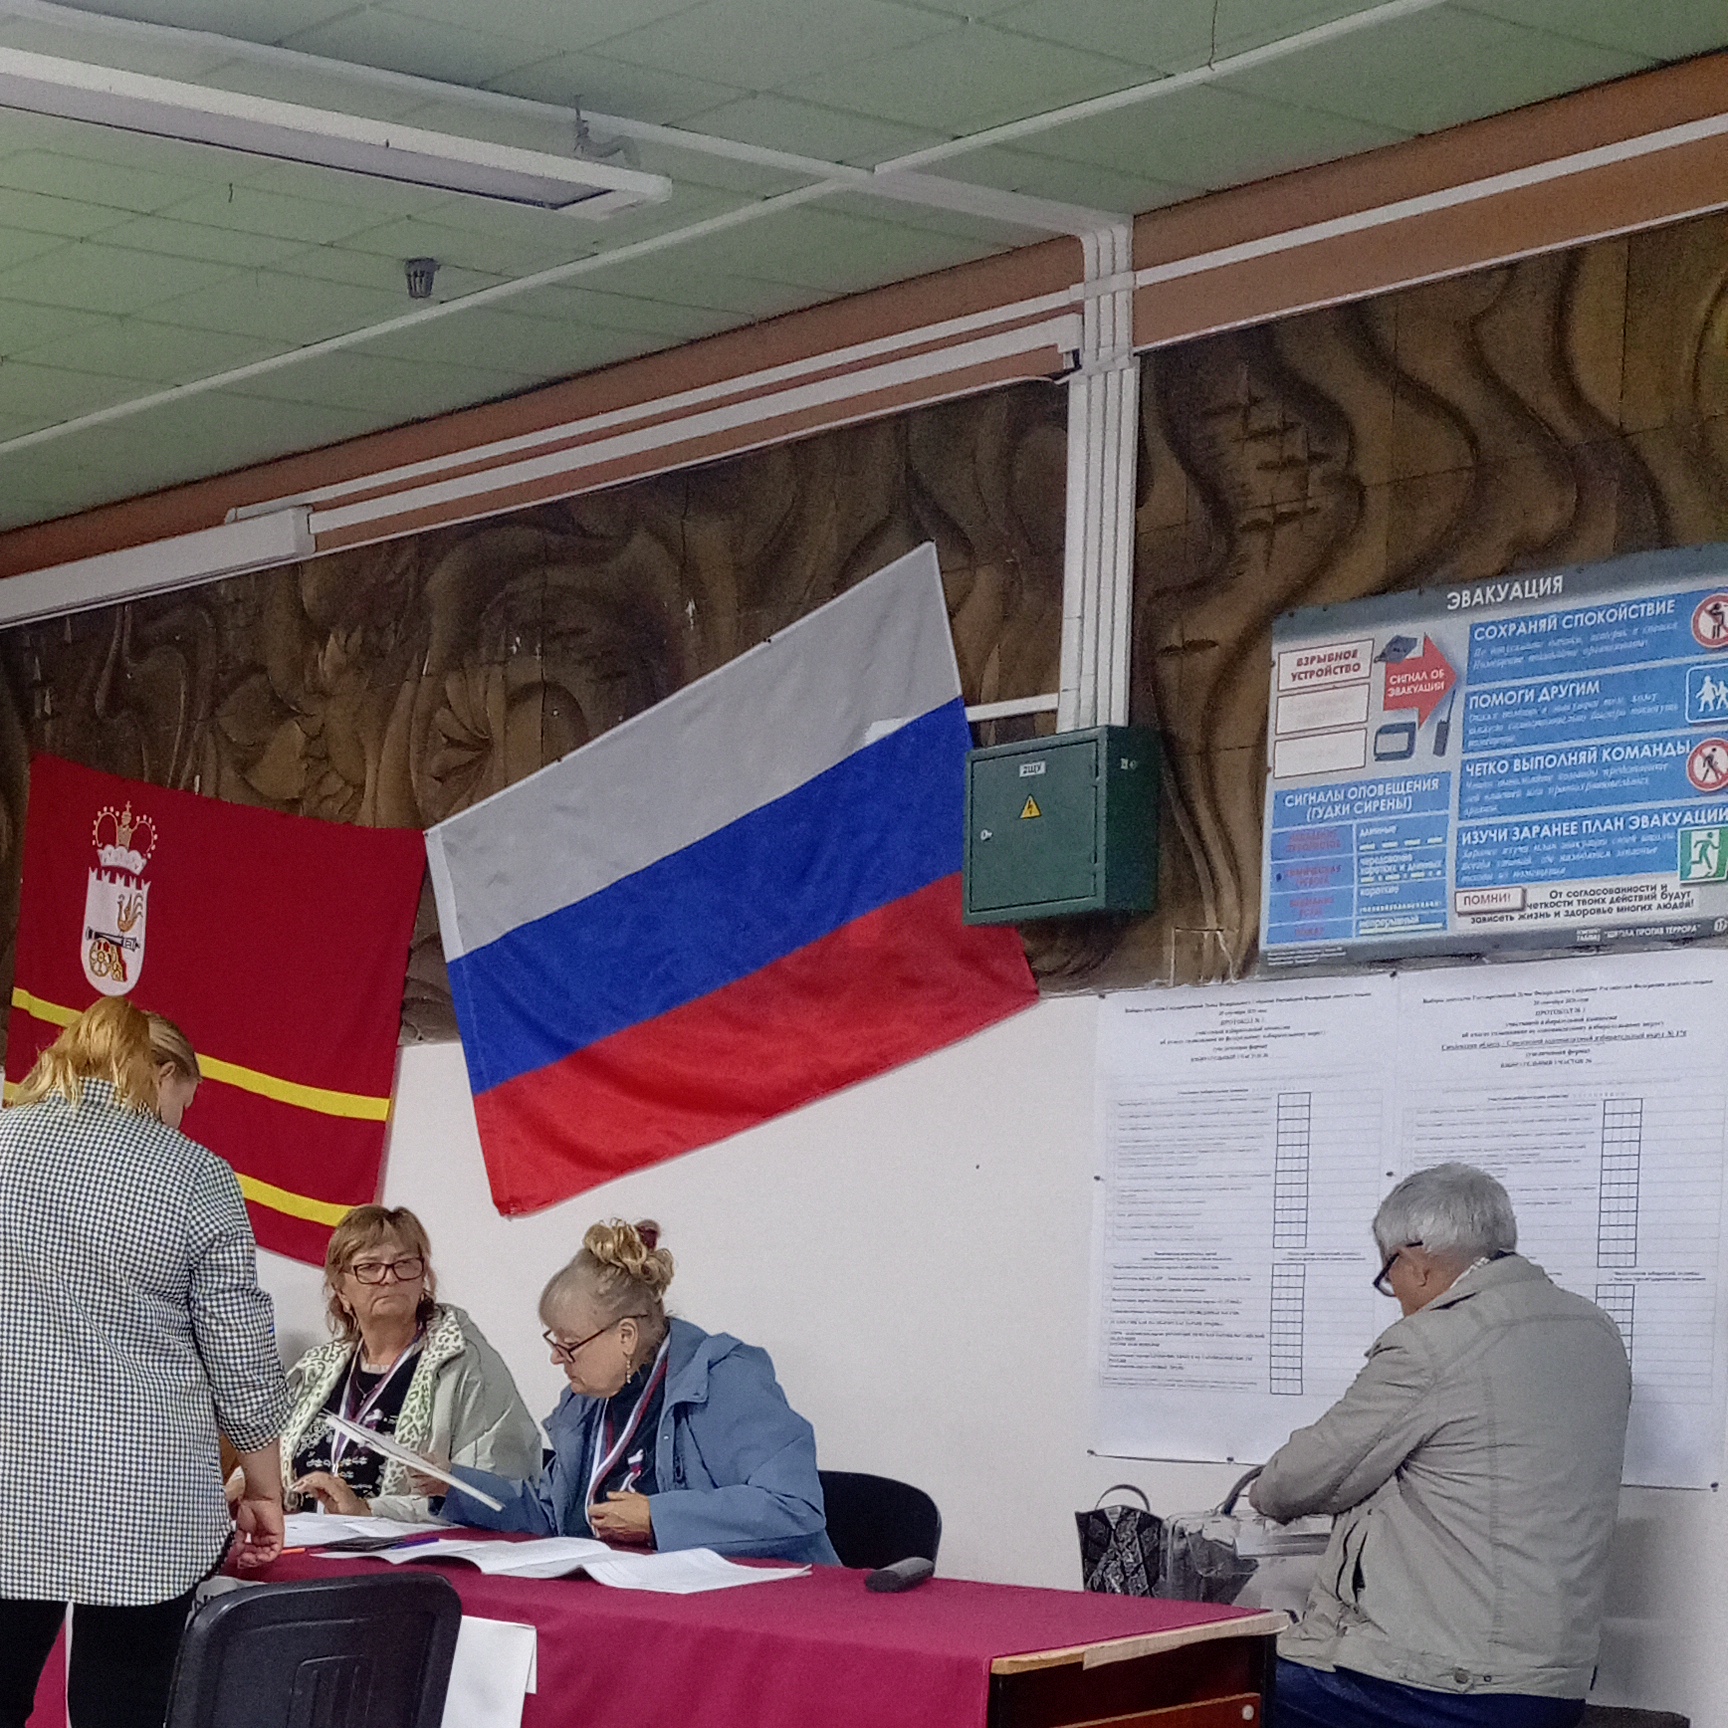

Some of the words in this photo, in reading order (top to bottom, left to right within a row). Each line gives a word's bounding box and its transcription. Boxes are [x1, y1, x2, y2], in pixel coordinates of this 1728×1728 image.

[1447, 575, 1563, 610] ЭВАКУАЦИЯ
[1474, 614, 1557, 641] СОХРАНЯЙ
[1562, 600, 1676, 629] СПОКОЙСТВИЕ
[1296, 649, 1358, 667] ВЗРЫВНОЕ
[1291, 663, 1361, 681] УСТРОЙСТВО
[1389, 673, 1428, 685] СИГНАЛ
[1430, 669, 1445, 680] ОБ
[1387, 682, 1445, 697] ЭВАКУАЦИИ
[1469, 687, 1535, 710] ПОМОГИ
[1538, 680, 1601, 703] ДРУГИМ
[1466, 760, 1509, 777] ЧЕТКО
[1513, 748, 1598, 773] ВЫПОЛНЯЙ
[1601, 740, 1691, 763] КОМАНДЫ
[1285, 791, 1344, 807] СИГНАЛЫ
[1348, 777, 1440, 800] ОПОВЕЩЕНИЯ
[1306, 802, 1351, 822] (ГУДКИ
[1353, 795, 1412, 815] СИРЕНЫ)
[1462, 828, 1508, 846] ИЗУЧИ
[1511, 822, 1578, 841] ЗАРАНЕЕ
[1582, 817, 1624, 834] ПЛАН
[1629, 808, 1728, 829] ЭВАКУАЦИИ
[1464, 893, 1511, 906] ПОМНИ!
[1526, 900, 1573, 910] четкости
[1577, 898, 1606, 907] твоих
[1609, 892, 1657, 904] действий
[1660, 890, 1692, 903] будут
[1550, 889, 1563, 899] От
[1566, 884, 1656, 898] согласованности
[1471, 914, 1515, 924] зависеть
[1518, 911, 1551, 921] жизнь
[1564, 907, 1614, 920] здоровье
[1617, 903, 1653, 913] многих
